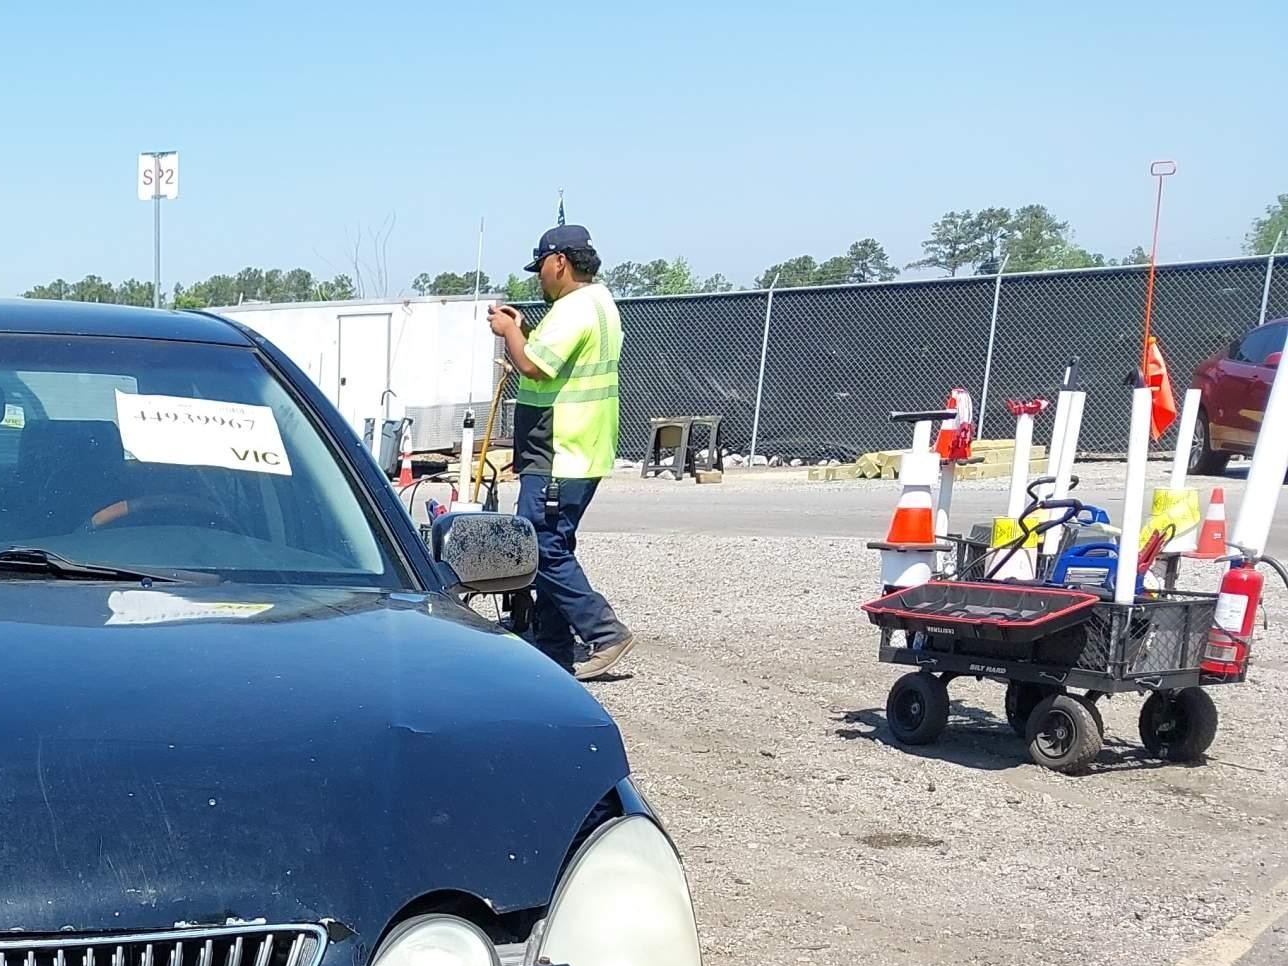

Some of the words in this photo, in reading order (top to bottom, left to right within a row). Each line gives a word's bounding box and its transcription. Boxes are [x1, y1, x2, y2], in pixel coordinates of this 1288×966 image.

[230, 447, 281, 466] VIC
[969, 664, 985, 672] BILT
[986, 666, 1006, 674] HARD
